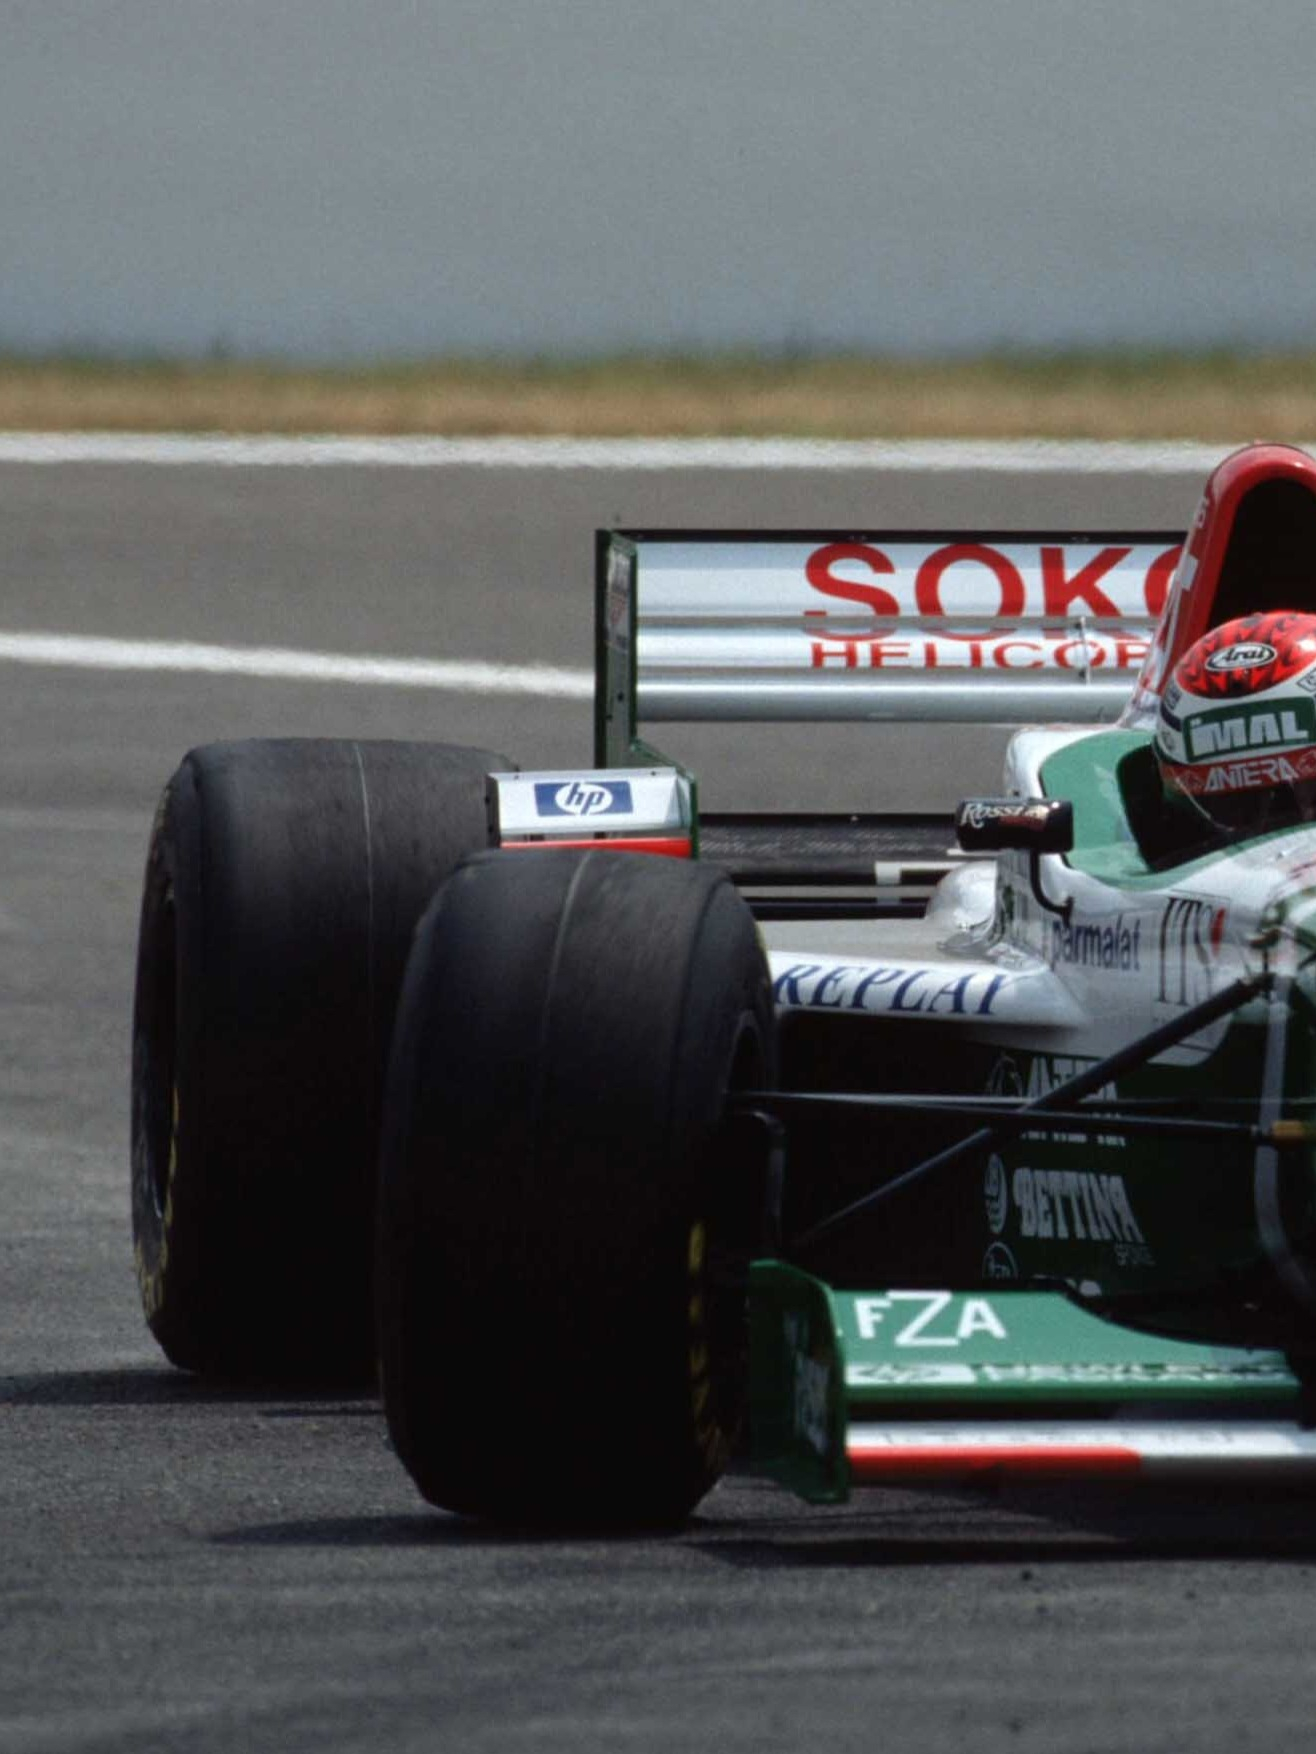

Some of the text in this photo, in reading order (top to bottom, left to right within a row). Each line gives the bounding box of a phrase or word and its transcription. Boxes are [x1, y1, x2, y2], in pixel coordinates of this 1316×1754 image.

[1222, 646, 1268, 664] Arai
[564, 782, 606, 815] hp
[773, 963, 1020, 1015] REPLAY
[854, 1289, 1008, 1346] FZA
